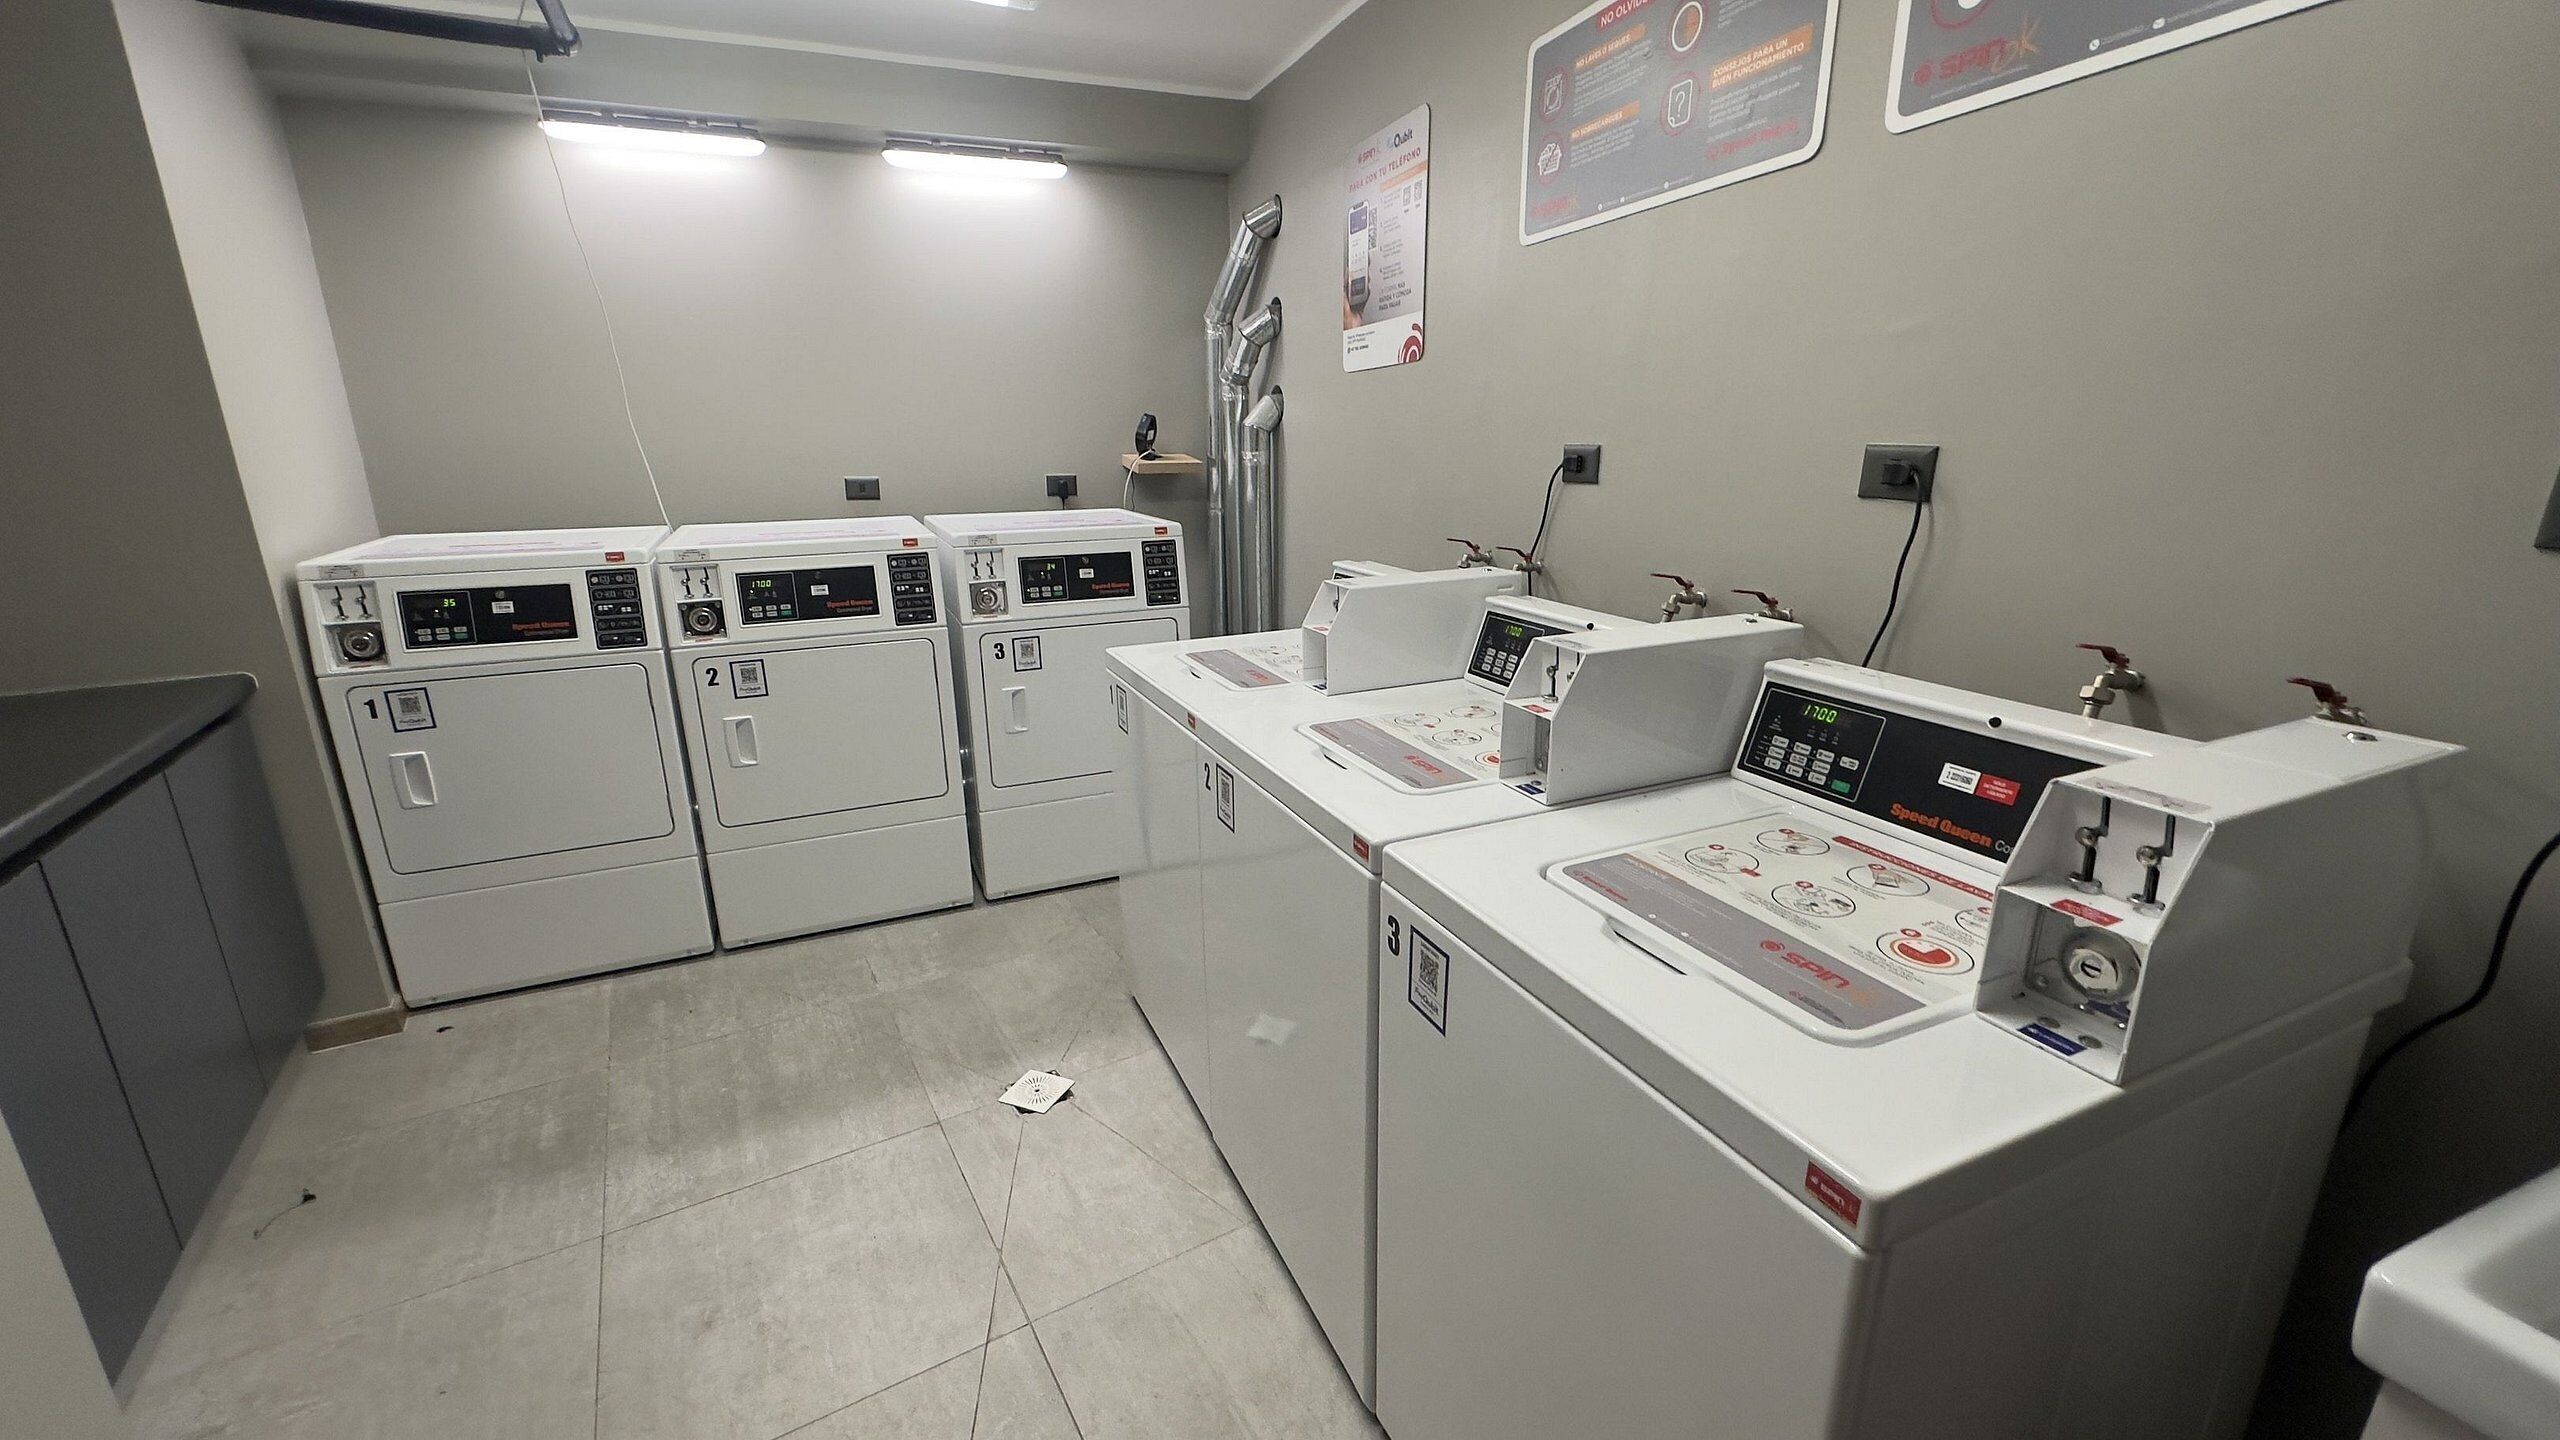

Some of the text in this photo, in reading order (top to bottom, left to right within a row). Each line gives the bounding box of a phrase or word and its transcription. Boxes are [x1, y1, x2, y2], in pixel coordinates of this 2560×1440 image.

[1600, 0, 1648, 28] NO OLVID
[1712, 42, 1804, 89] BUEN FUNCIONAMIENTO
[1713, 38, 1788, 77] CONSEJOS PARA UN
[751, 579, 772, 588] 1700
[443, 598, 456, 608] 35
[993, 642, 1006, 660] 3
[705, 667, 720, 687] 2
[363, 699, 379, 719] 1
[1803, 704, 1838, 724] 1700
[1204, 762, 1211, 791] 2
[1890, 803, 2014, 854] Speed Queen Co
[1387, 914, 1401, 957] 3
[1781, 951, 1851, 990] SPIN
